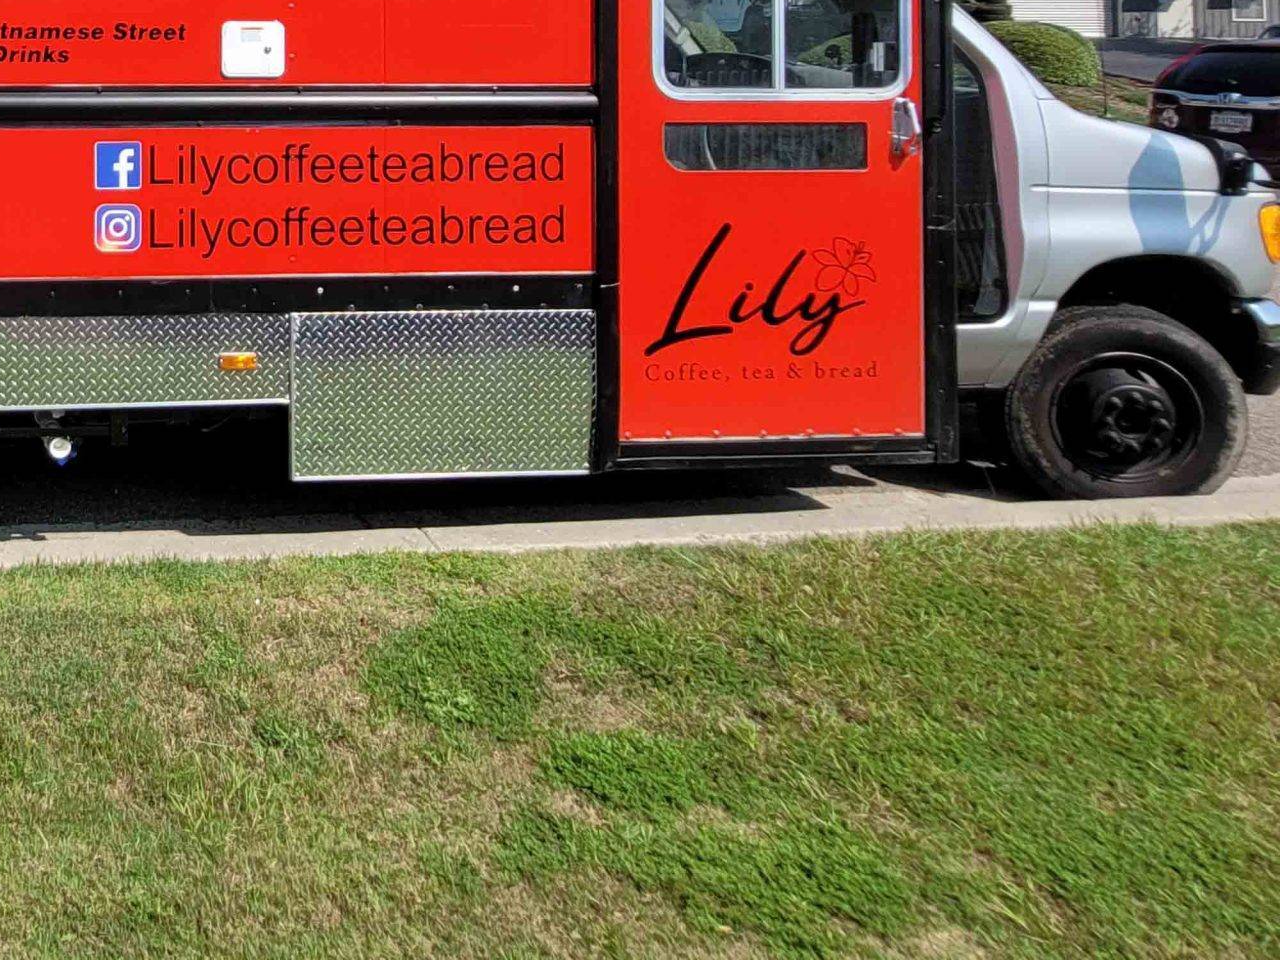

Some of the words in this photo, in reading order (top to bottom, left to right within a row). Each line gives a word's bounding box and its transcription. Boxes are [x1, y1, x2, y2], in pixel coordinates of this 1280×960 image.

[113, 22, 187, 41] Street
[148, 142, 566, 196] Lilycoffeeteabread
[148, 204, 566, 259] Lilycoffeeteabread
[644, 222, 866, 356] Lily
[645, 362, 731, 382] Coffee,
[742, 365, 775, 380] tea
[786, 363, 803, 379] &
[814, 361, 880, 379] bread
